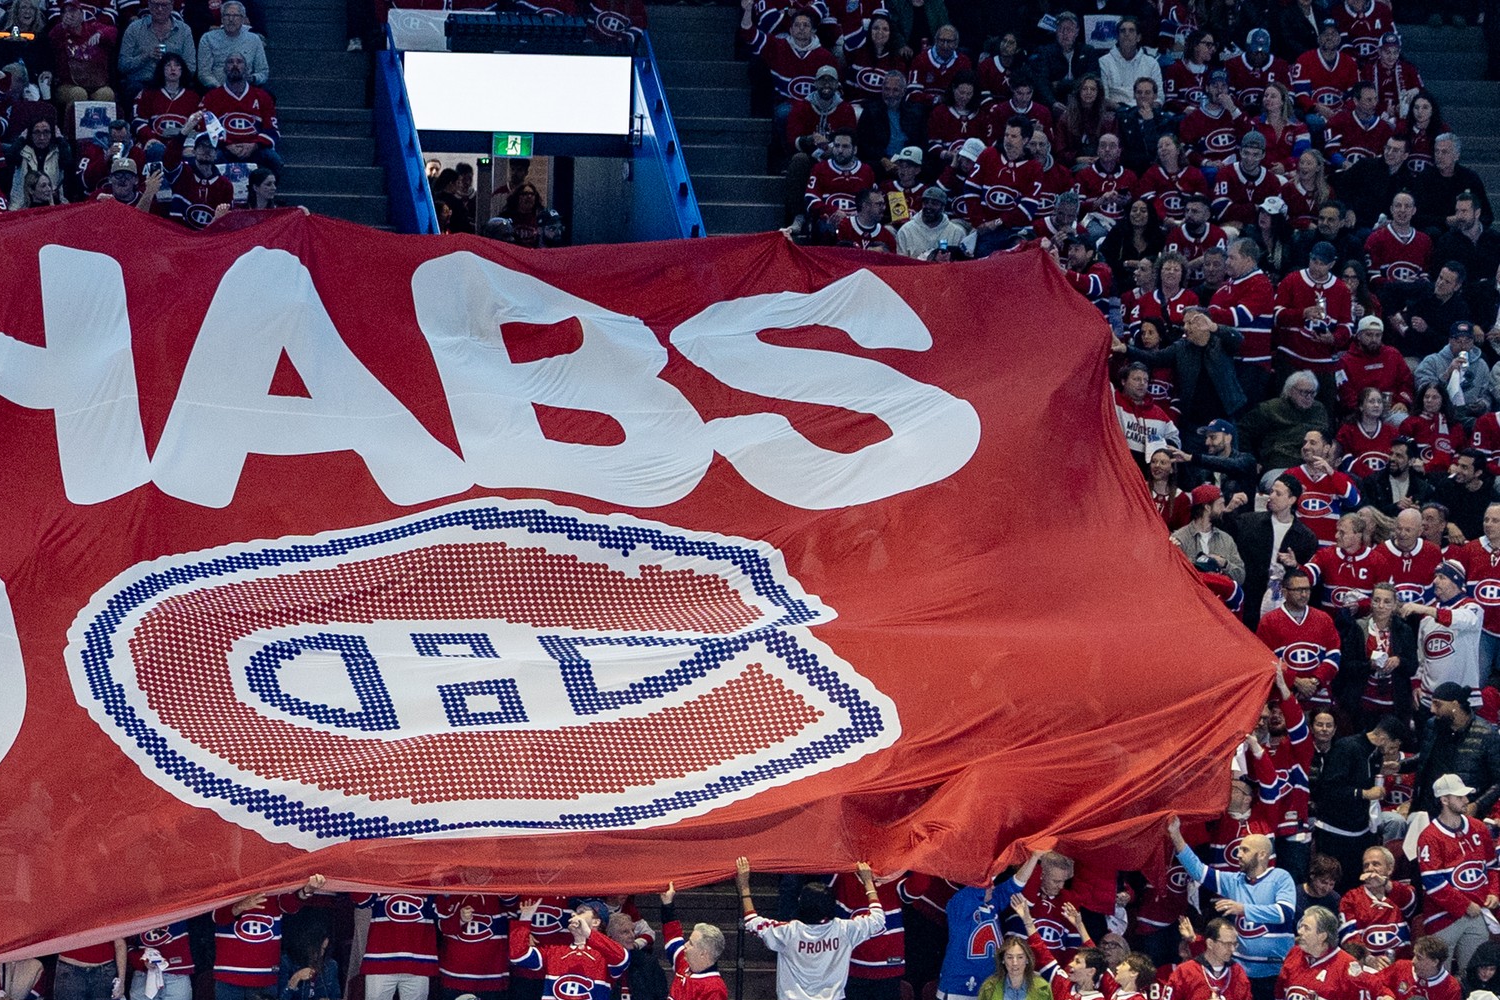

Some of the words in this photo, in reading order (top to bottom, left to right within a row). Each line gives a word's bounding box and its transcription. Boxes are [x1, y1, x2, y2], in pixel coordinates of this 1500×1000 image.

[1213, 181, 1229, 195] 48
[1472, 832, 1482, 846] C
[798, 937, 840, 954] PROMO
[1315, 968, 1328, 982] A
